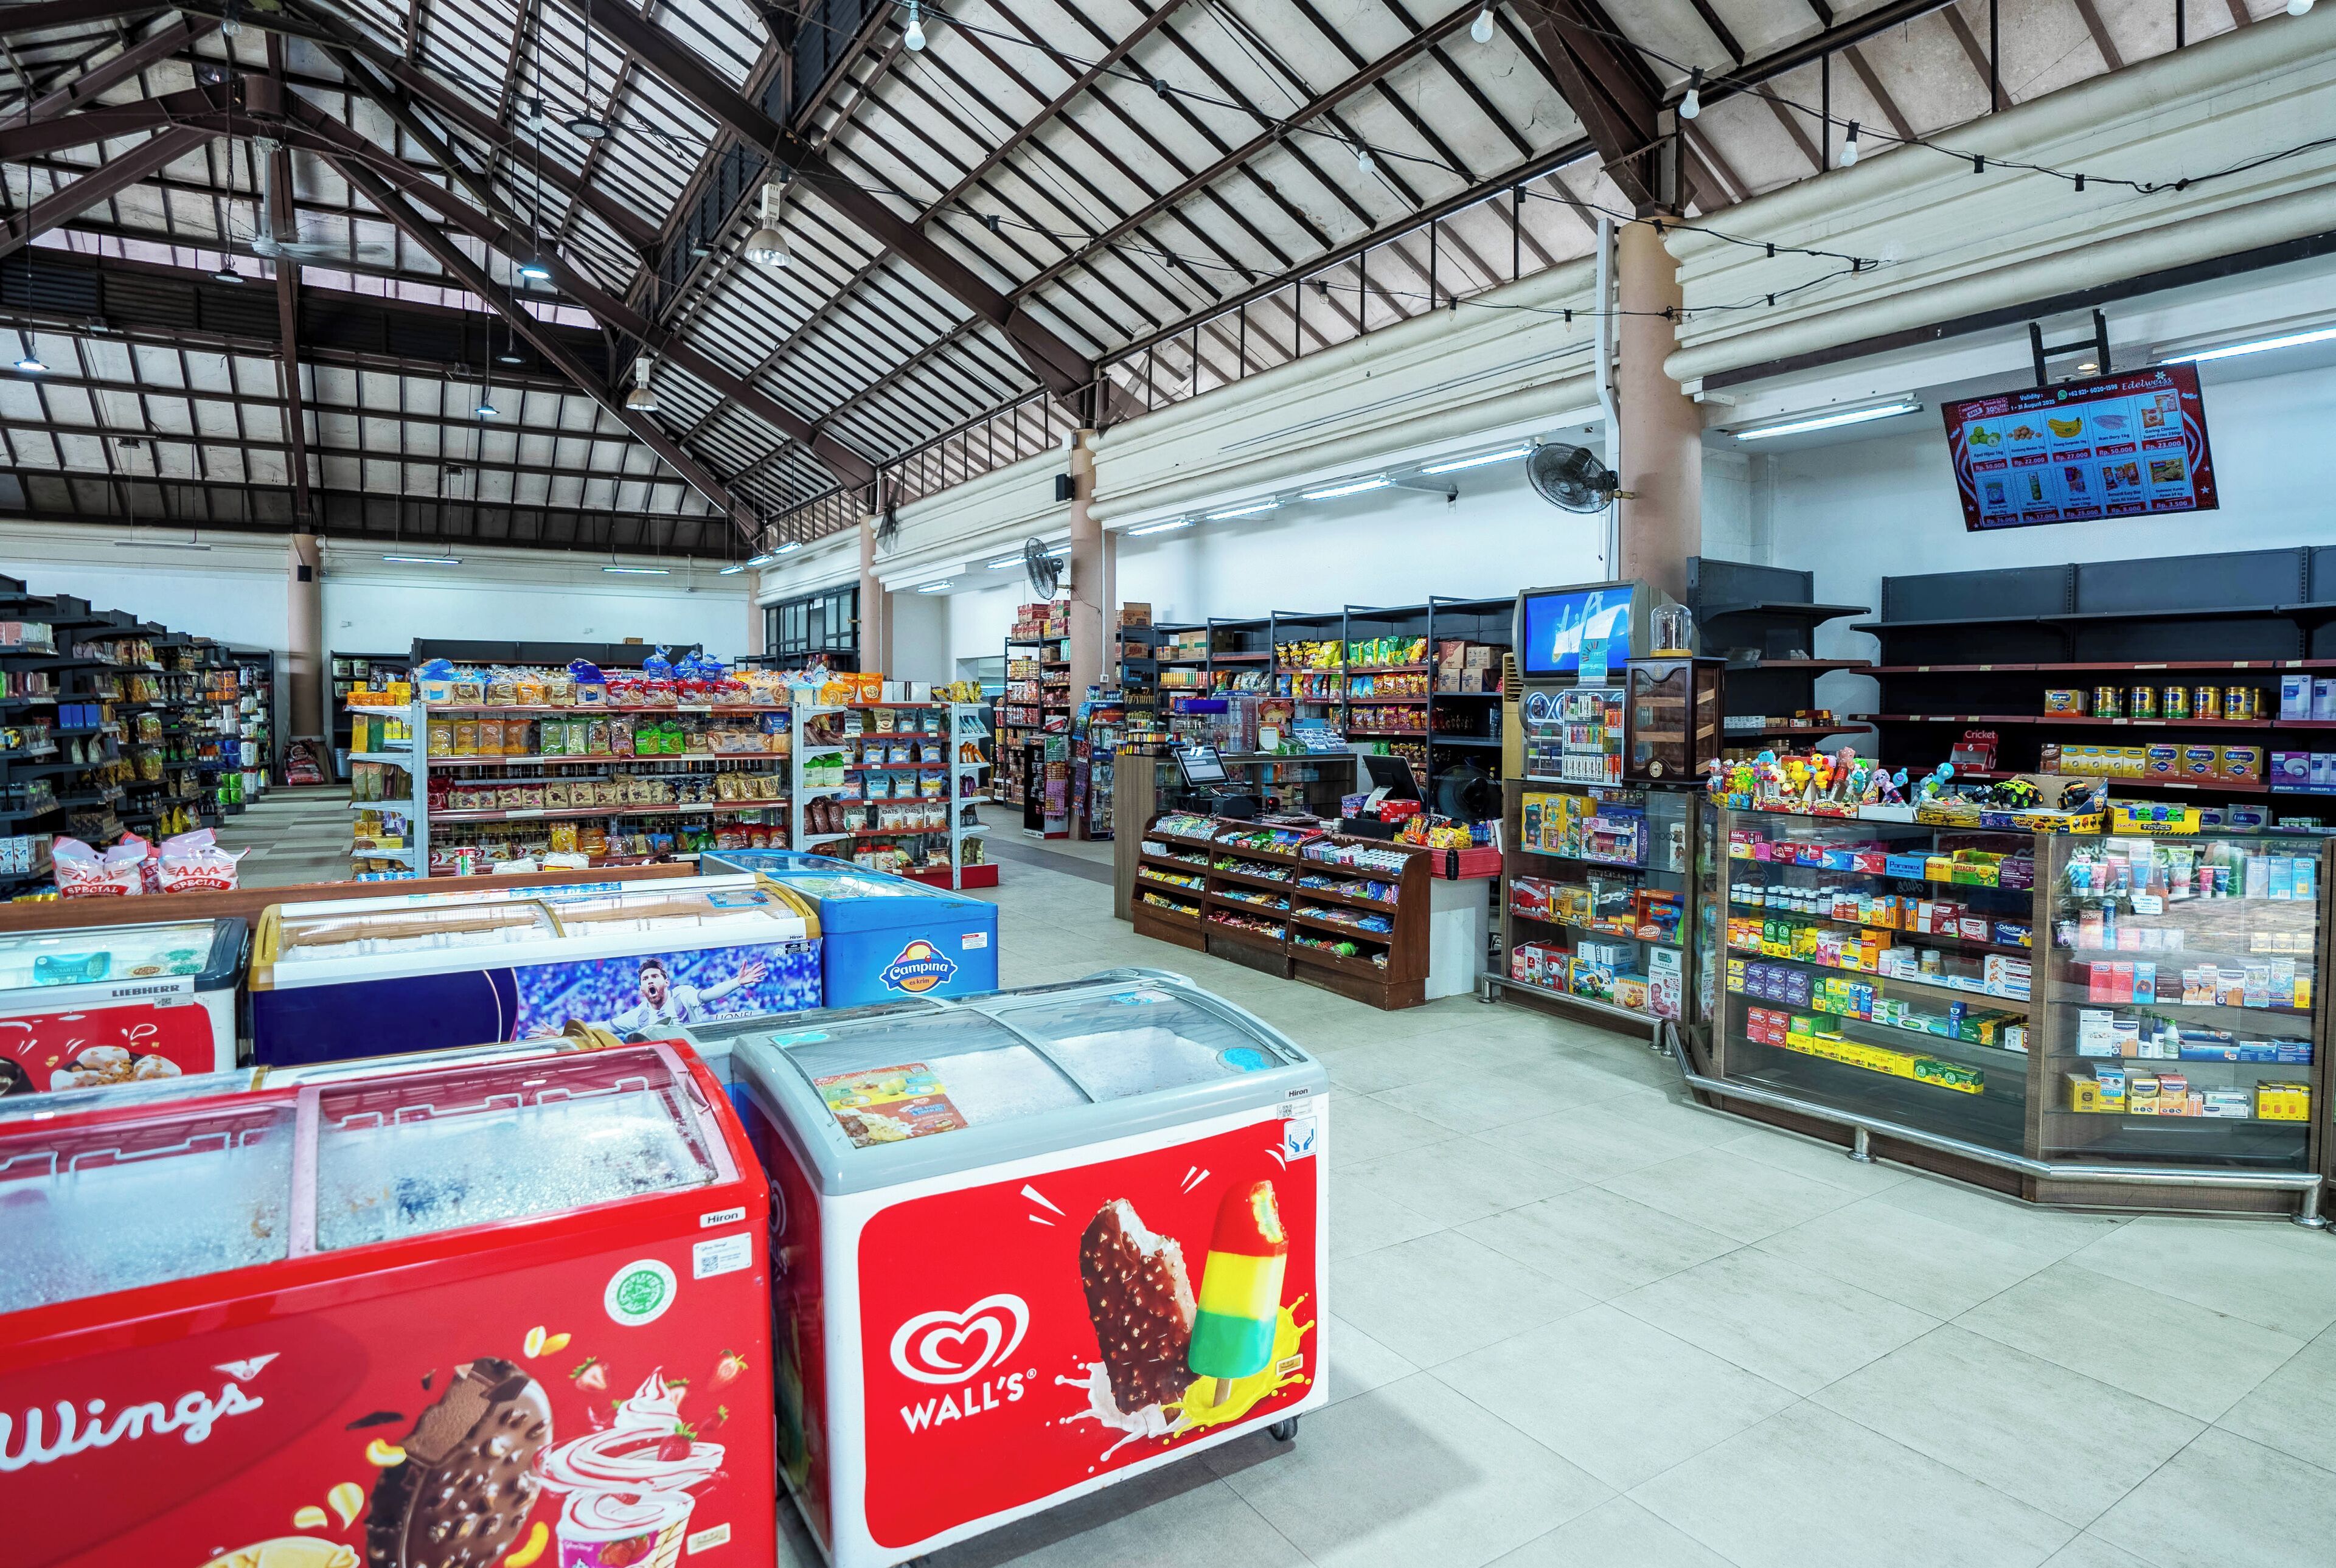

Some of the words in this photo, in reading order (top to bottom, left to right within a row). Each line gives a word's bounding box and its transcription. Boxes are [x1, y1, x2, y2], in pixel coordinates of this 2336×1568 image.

[2122, 378, 2173, 390] Edelweiss
[1965, 730, 1995, 739] Cricket
[176, 866, 221, 876] AAA
[1889, 861, 1920, 870] Paramex
[1954, 864, 1976, 873] MIXAGRIP
[72, 870, 114, 884] AAA
[172, 878, 222, 890] SPECIAL
[67, 886, 118, 895] SPECIAL
[889, 961, 948, 980] Campina
[112, 985, 179, 997] LIEBHERR
[2005, 988, 2030, 997] Counterpain
[1288, 1089, 1308, 1097] Hiron
[707, 1212, 739, 1224] Hiron
[900, 1372, 1024, 1434] WALL'S
[0, 1382, 263, 1472] Wings
